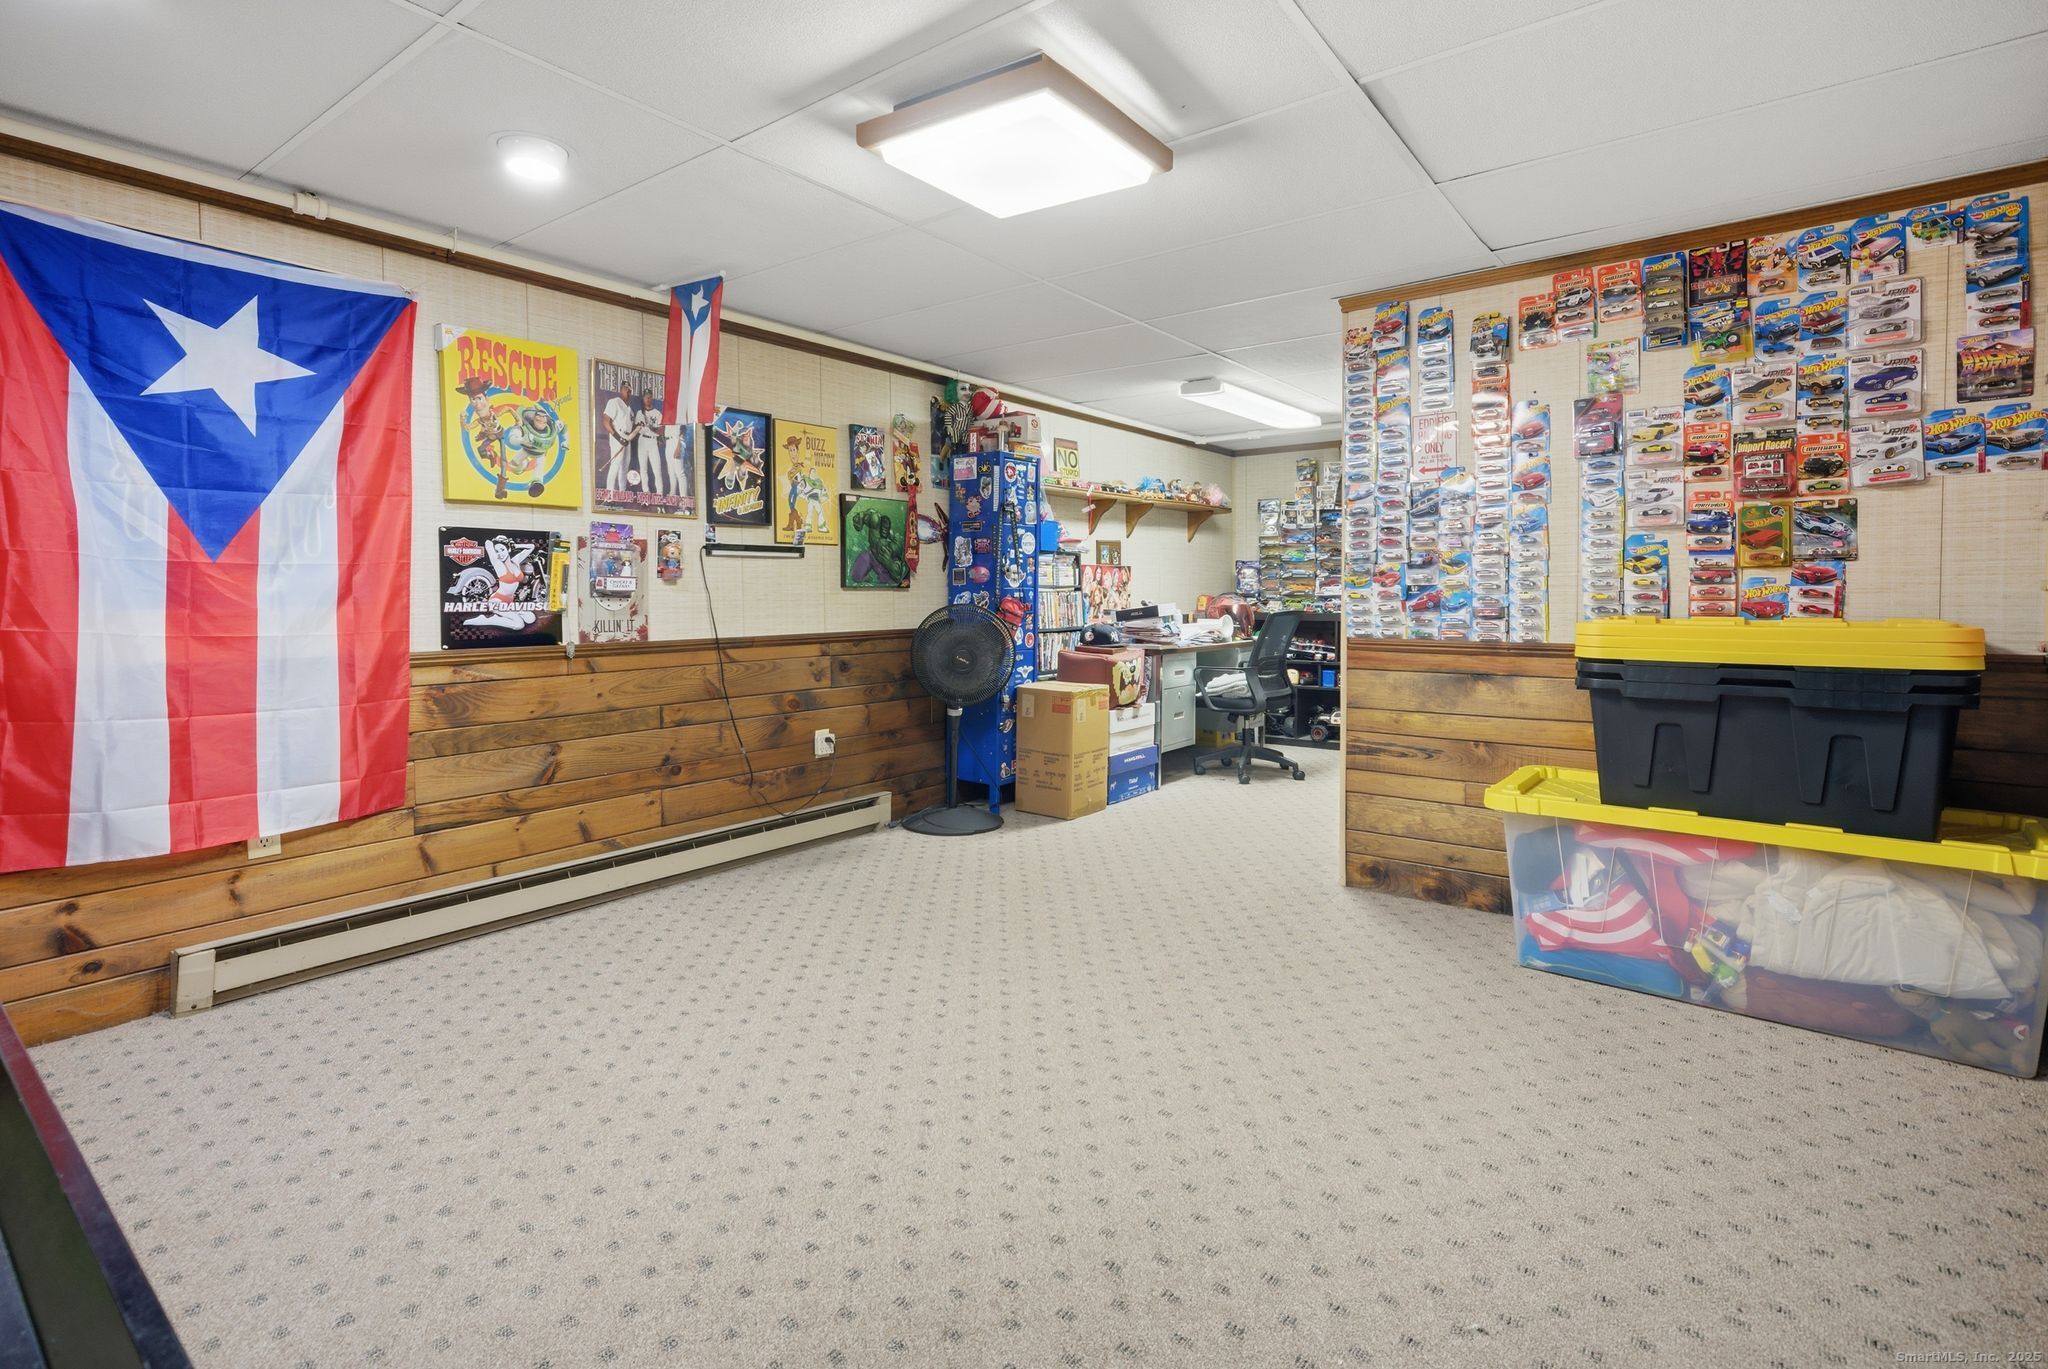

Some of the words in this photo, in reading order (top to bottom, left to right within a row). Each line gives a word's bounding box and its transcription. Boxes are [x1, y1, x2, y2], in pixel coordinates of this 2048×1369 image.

[457, 336, 557, 402] RESCUE
[599, 362, 617, 392] THE
[642, 372, 664, 400] GENE
[806, 436, 826, 451] BUZZ
[1425, 442, 1444, 454] ONLY
[1058, 449, 1078, 468] NO
[444, 602, 550, 612] HARLEY-DAVIDS
[594, 620, 623, 632] KILLIN'
[626, 620, 635, 632] IT
